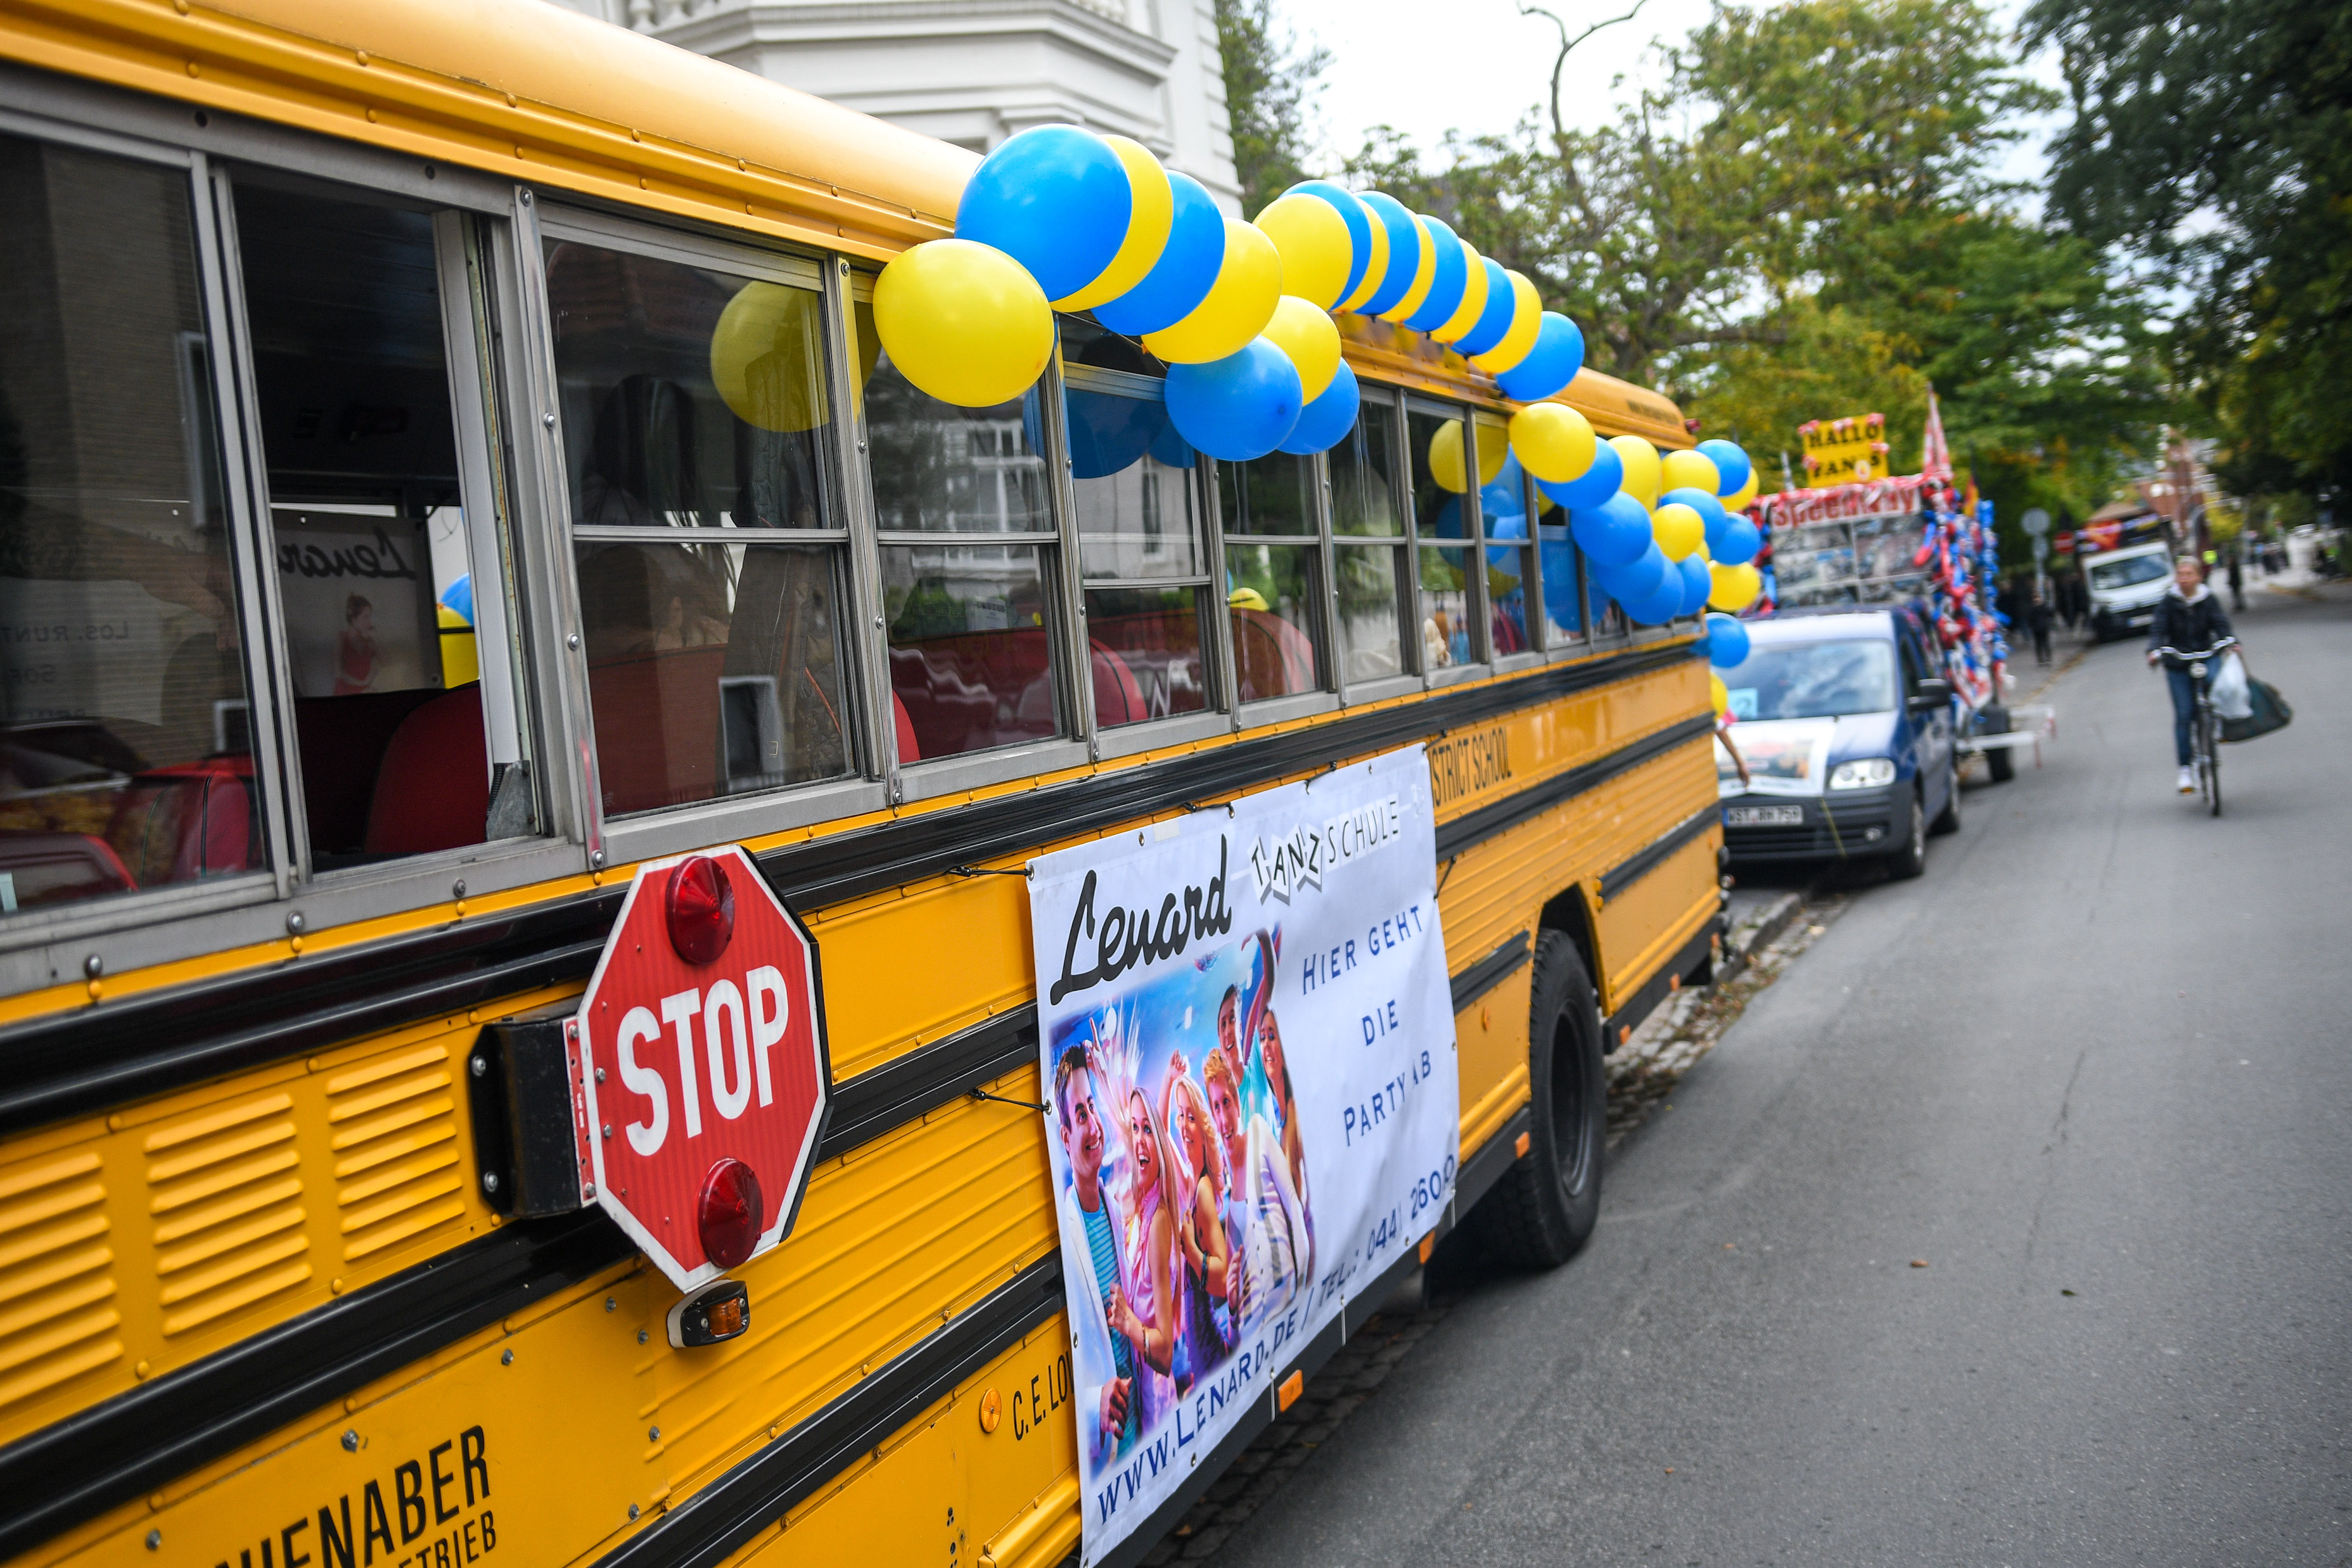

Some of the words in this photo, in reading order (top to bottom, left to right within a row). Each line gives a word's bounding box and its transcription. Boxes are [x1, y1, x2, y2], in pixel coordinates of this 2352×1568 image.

[1472, 726, 1512, 791] SCHOOL
[1050, 833, 1232, 1006] Lenard
[1303, 938, 1358, 995] HIER
[1368, 905, 1422, 956] GEHT
[617, 964, 789, 1157] STOP
[1362, 999, 1399, 1047] DIE
[1343, 1072, 1406, 1147] PARTY
[1013, 1390, 1029, 1441] C.
[1031, 1374, 1047, 1427] E.
[214, 1425, 492, 1568] ENABER
[397, 1510, 497, 1568] TRIEB
